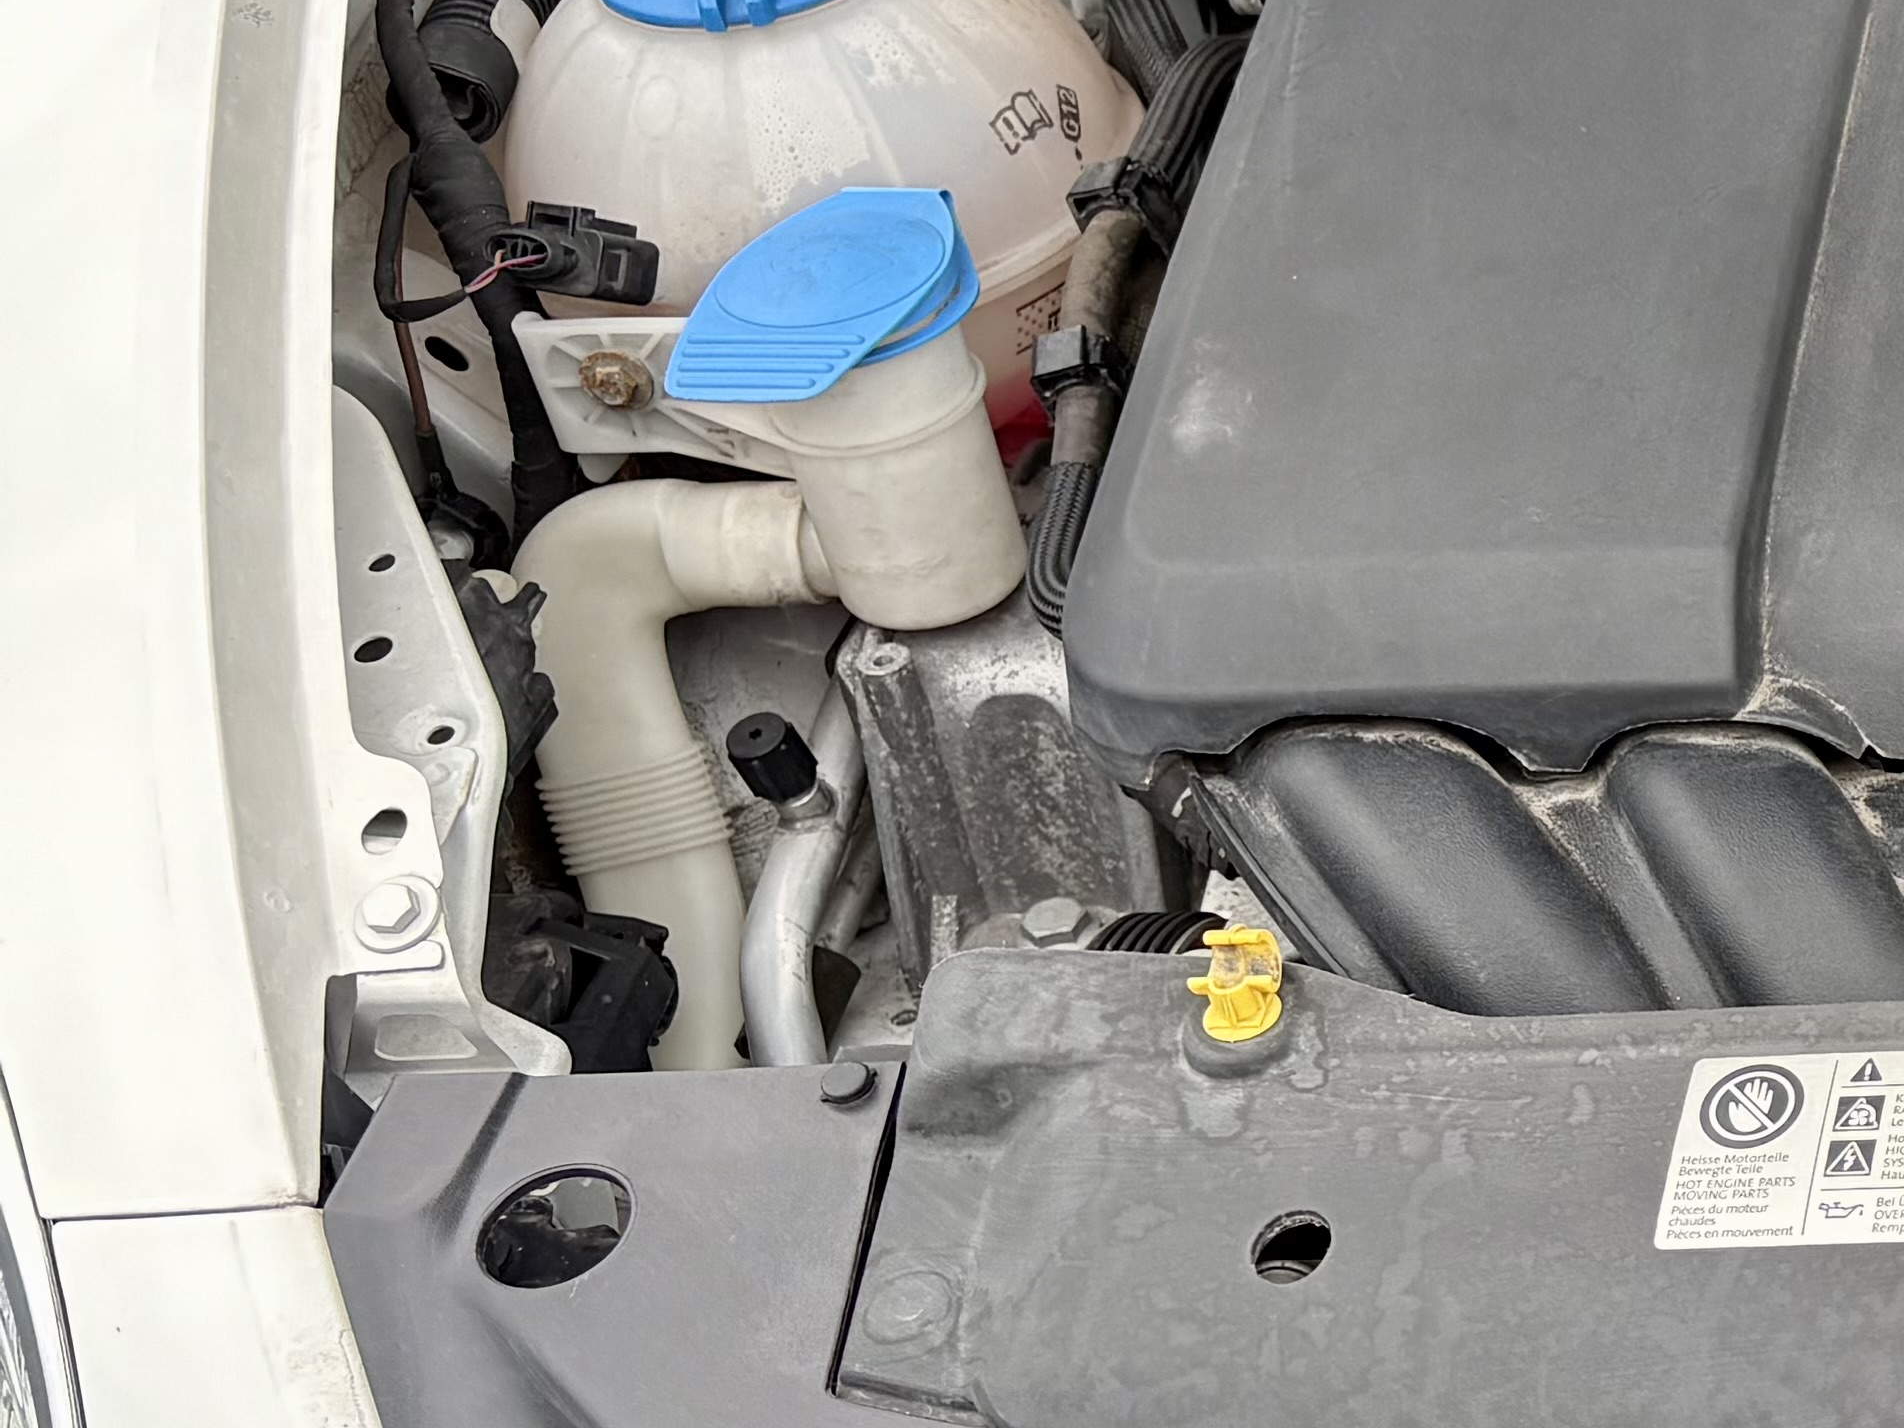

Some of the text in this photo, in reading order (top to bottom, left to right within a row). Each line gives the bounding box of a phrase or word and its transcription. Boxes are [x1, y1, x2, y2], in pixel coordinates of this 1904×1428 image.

[1060, 88, 1079, 137] G12
[1891, 1117, 1904, 1127] Le
[1681, 1152, 1790, 1165] Heisse Motorteile
[1678, 1164, 1764, 1178] Bewegte Teile
[1676, 1176, 1796, 1190] HOT ENGINE PARTS
[1673, 1188, 1770, 1201] MOVING PARTS
[1876, 1196, 1895, 1207] Bei
[1671, 1204, 1770, 1215] Pièces du moteur
[1668, 1215, 1717, 1227] chaudes
[1666, 1225, 1794, 1239] Pièces en mouvement
